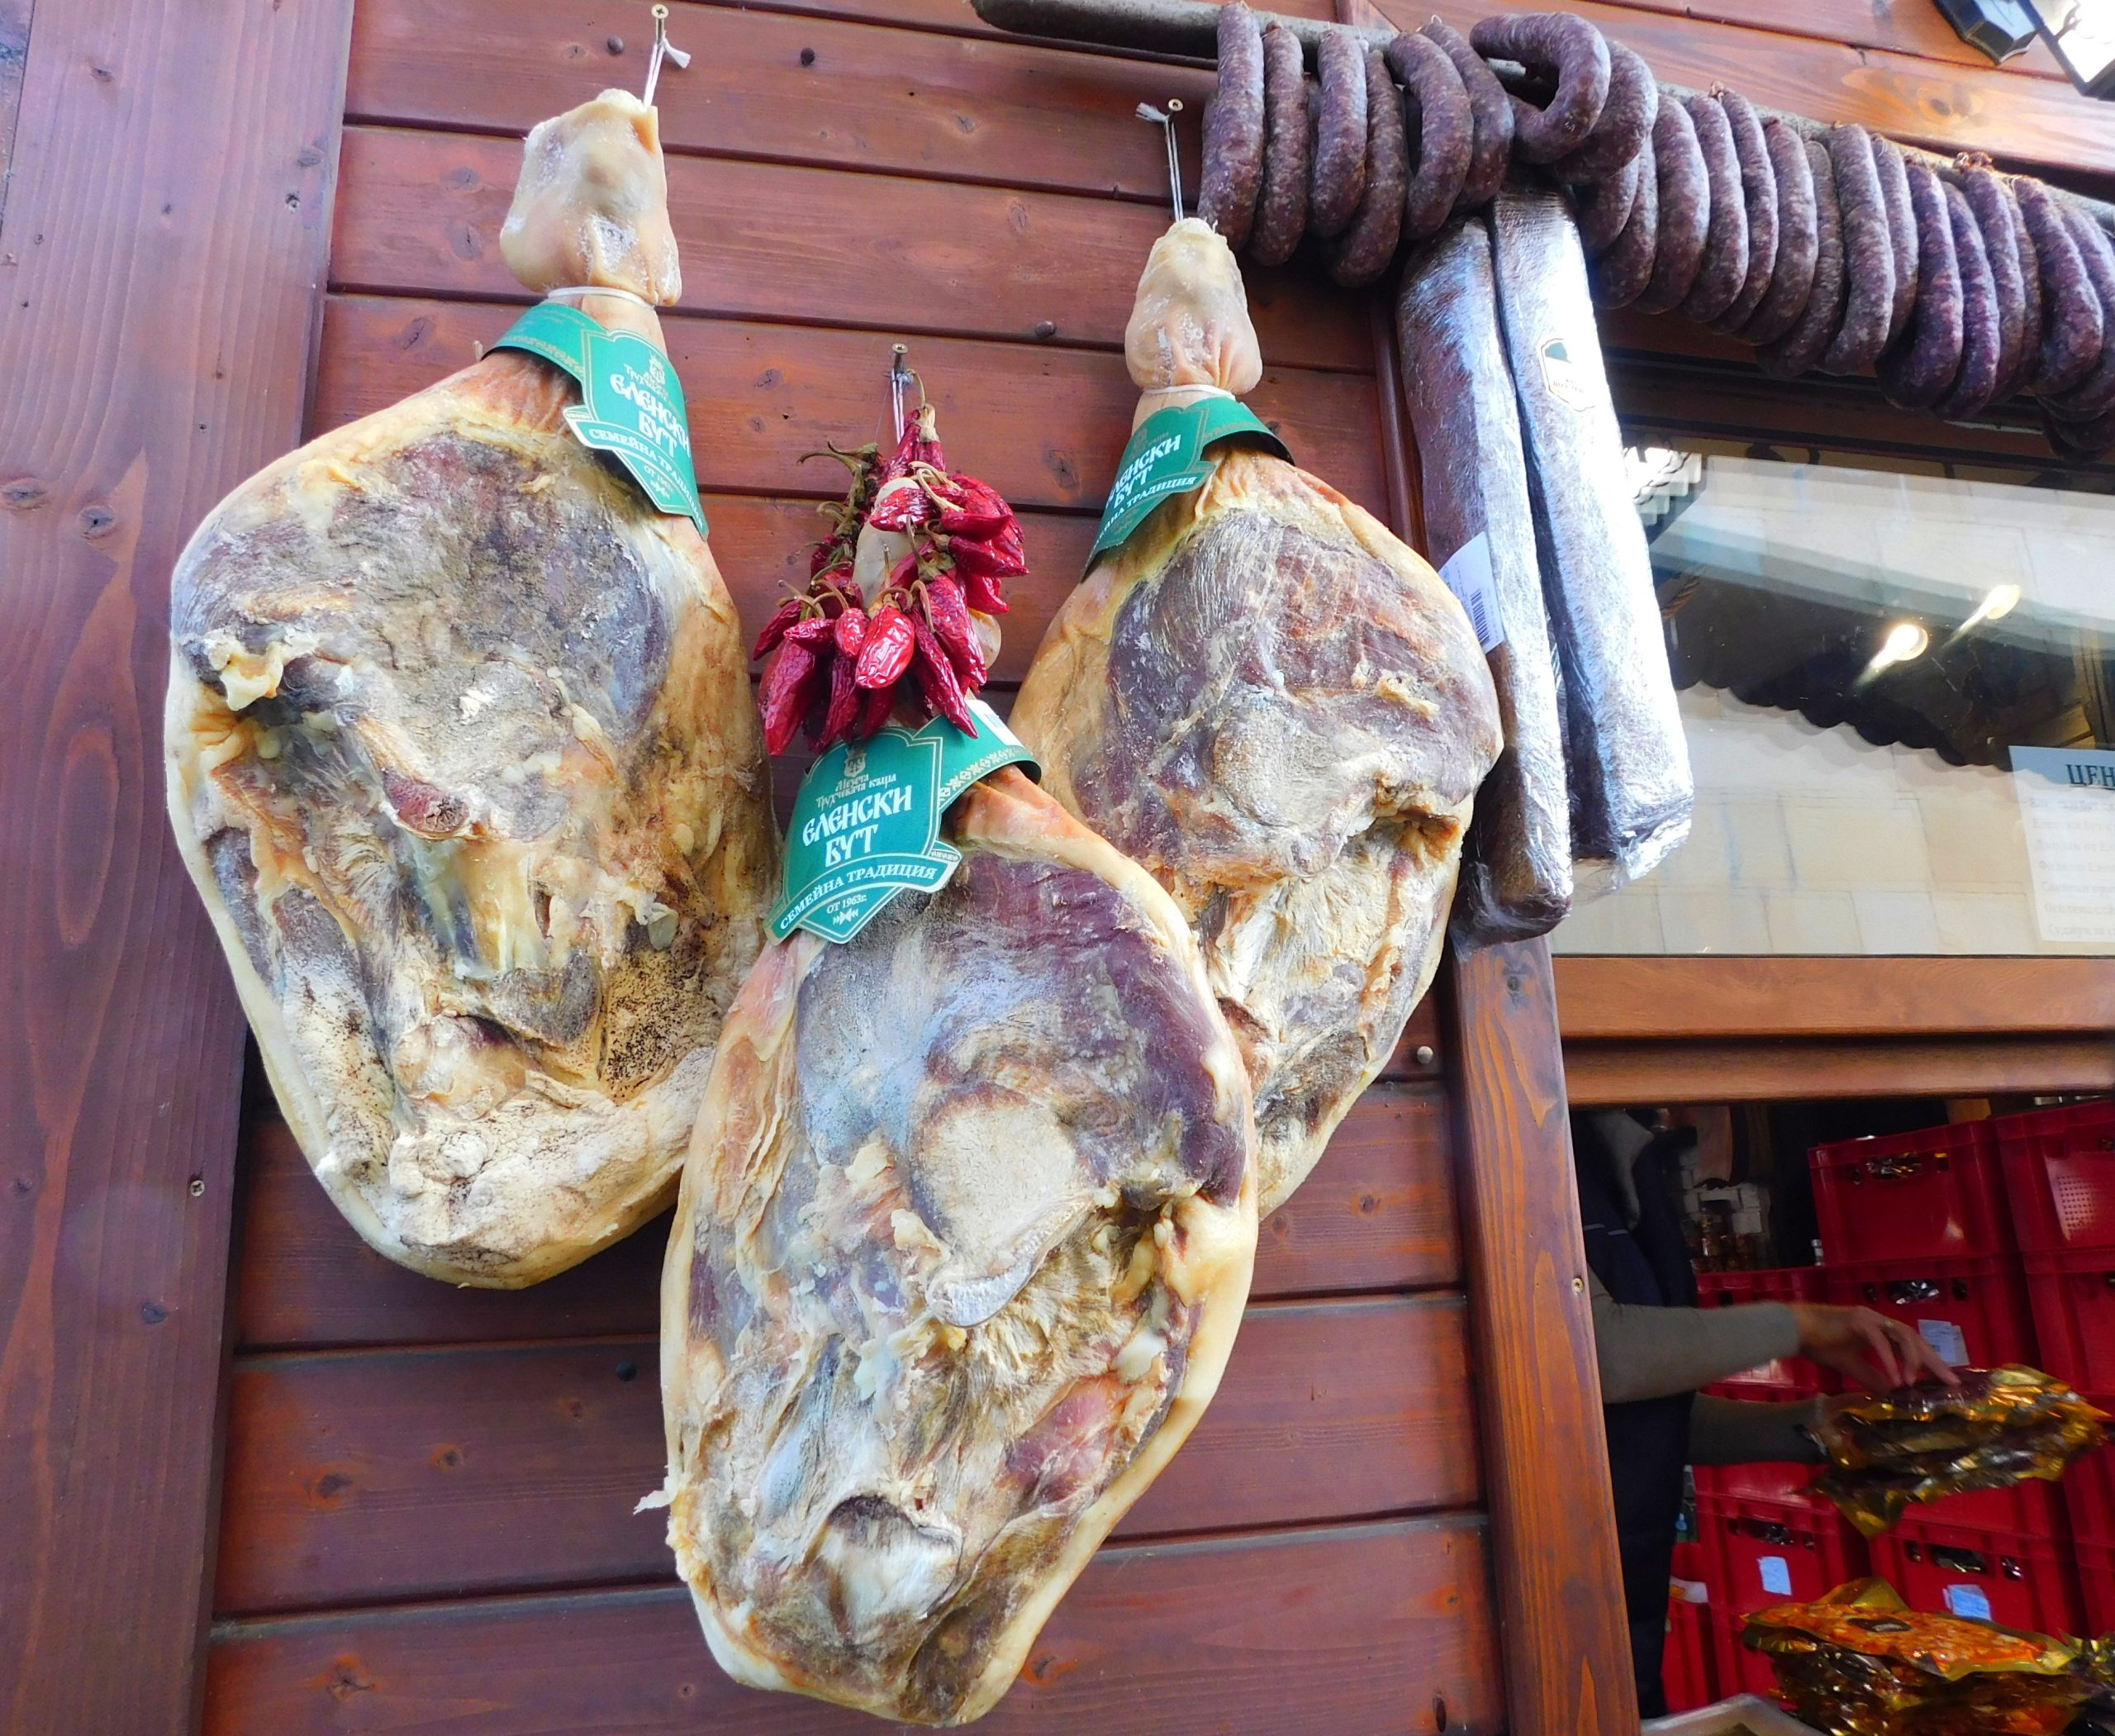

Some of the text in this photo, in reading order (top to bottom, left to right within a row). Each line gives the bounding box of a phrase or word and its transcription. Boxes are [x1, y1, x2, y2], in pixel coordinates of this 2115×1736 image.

[639, 410, 677, 458] БУТ
[1114, 464, 1153, 508] БУТ
[1126, 476, 1197, 508] ТРАДИЦИЯ
[825, 824, 879, 868] БУТ
[779, 863, 938, 930] СЕМЕЙНА ТРАДИЦИЯ
[826, 901, 841, 914] ОТ
